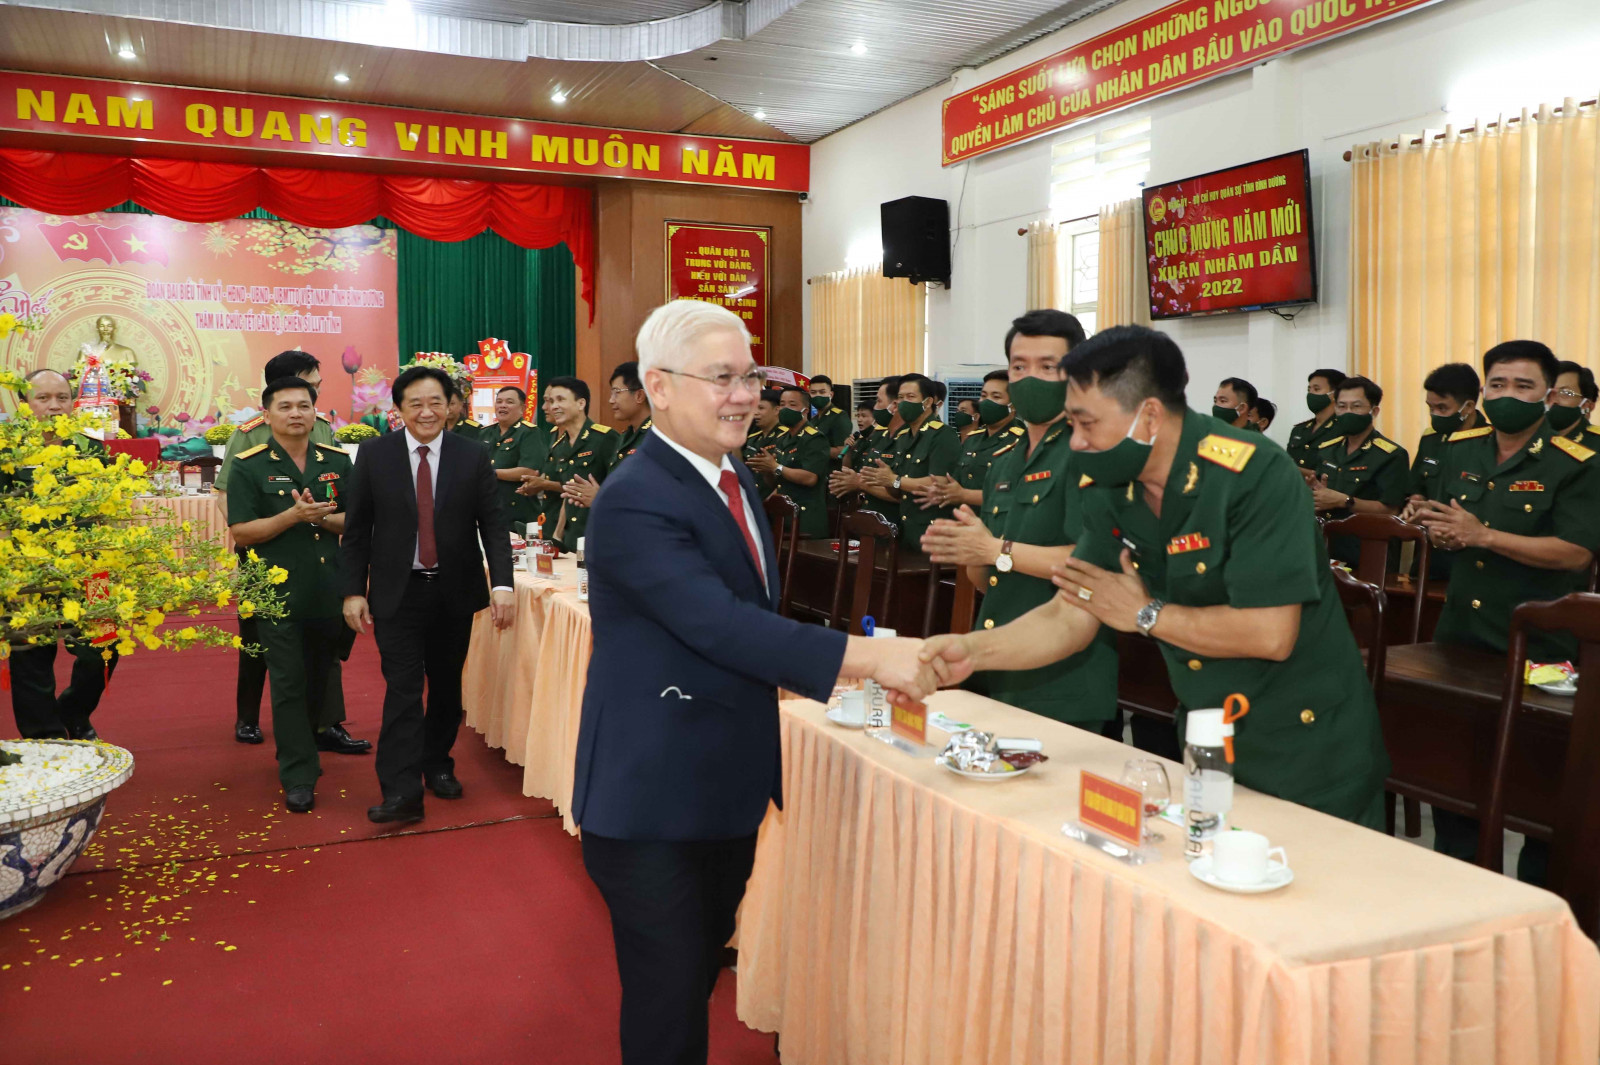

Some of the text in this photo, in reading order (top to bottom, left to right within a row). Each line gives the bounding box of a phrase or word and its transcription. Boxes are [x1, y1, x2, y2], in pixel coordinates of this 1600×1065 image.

[1018, 64, 1055, 99] SUỐT
[1092, 35, 1137, 71] CHỌN
[1142, 6, 1208, 51] NHỮNG
[951, 120, 992, 155] QUYỀN
[994, 109, 1023, 139] LÀM
[1027, 95, 1056, 128] CHỦ
[1060, 85, 1092, 116] CỦA
[1096, 68, 1143, 104] NHÂN
[1148, 51, 1187, 86] DÂN
[1193, 32, 1233, 70] BẦU
[1239, 19, 1283, 53] VÀO
[16, 88, 776, 181] NAM QUANG VINH MUÔN NĂM
[1209, 190, 1219, 202] HUY
[1220, 186, 1234, 200] QUÂN
[1243, 180, 1255, 194] TỈNH
[1154, 198, 1302, 258] CHÚC MỪNG NĂM MỚI
[723, 246, 738, 258] ĐỘI
[741, 249, 750, 258] TA
[1158, 242, 1298, 282] XUÂN NHÂM DẦN
[685, 258, 712, 268] TRUNG
[714, 258, 728, 269] VỚI
[691, 269, 711, 280] HIẾU
[713, 270, 727, 281] VỚI
[1202, 278, 1243, 298] 2022
[738, 298, 757, 308] SINH
